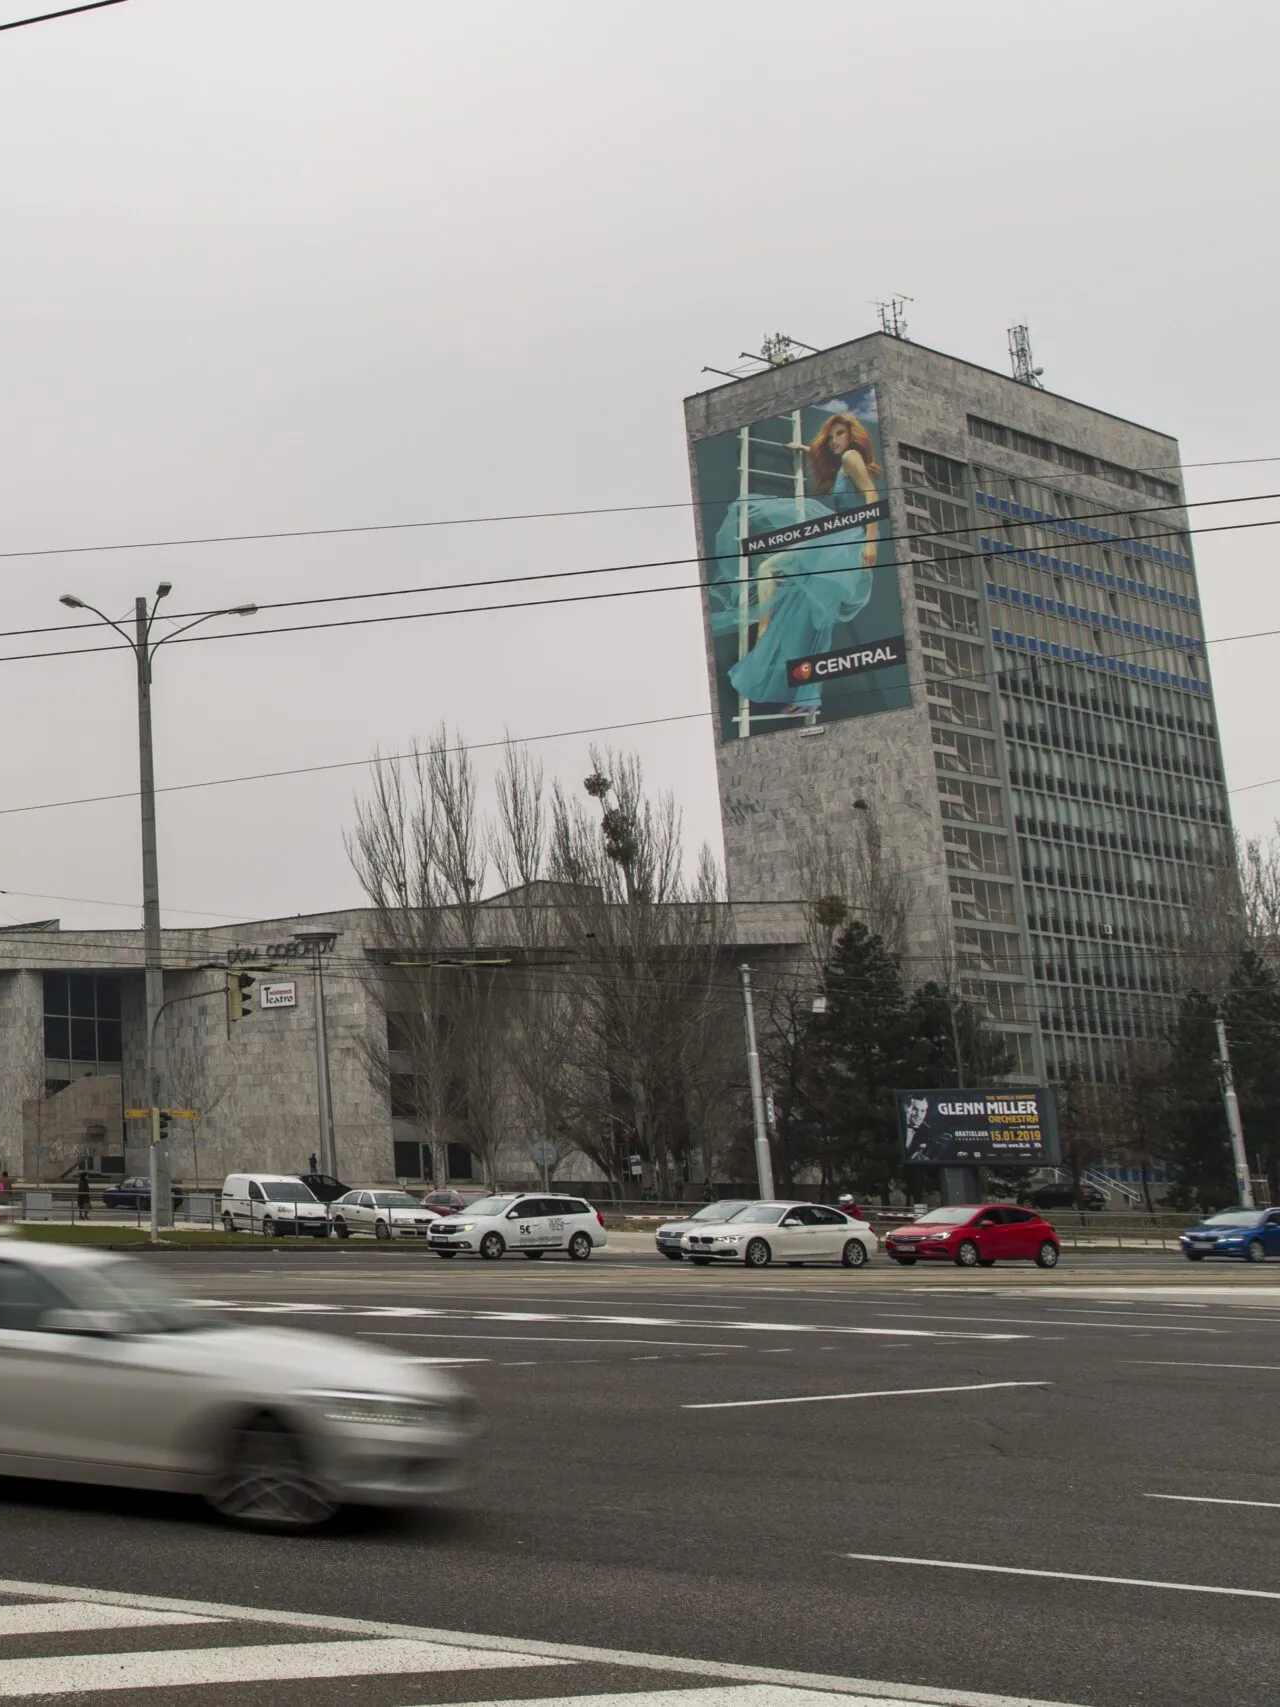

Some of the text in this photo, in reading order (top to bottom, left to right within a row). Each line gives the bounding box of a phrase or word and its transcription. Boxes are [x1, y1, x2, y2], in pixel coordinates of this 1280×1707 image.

[748, 507, 881, 552] NA KROK ZA NÁKUPMI
[815, 646, 898, 675] CENTRAL
[938, 1101, 1038, 1115] GLENN MILLER
[988, 1115, 1040, 1124] ORCHESTRA
[991, 1130, 1041, 1141] 15.01.2019
